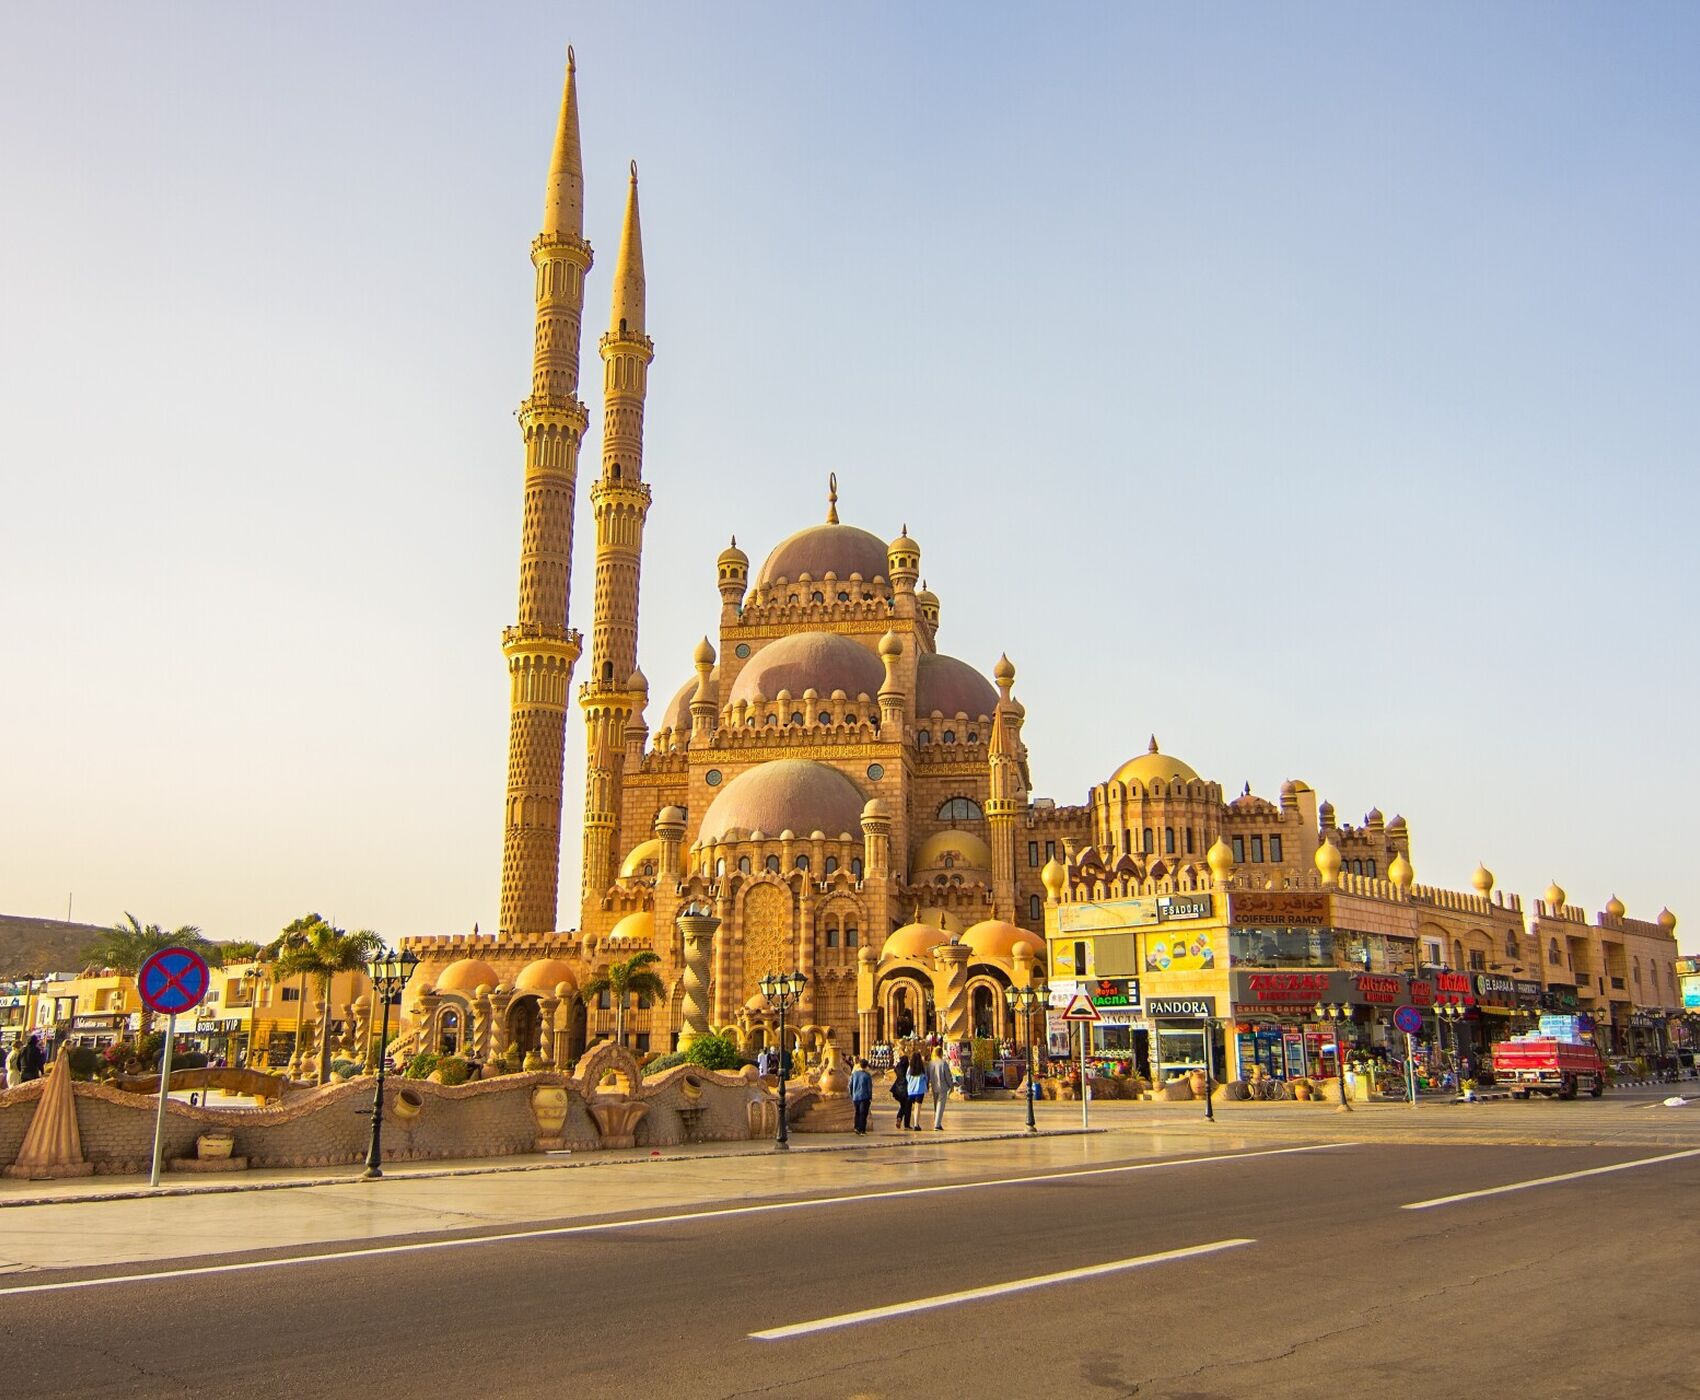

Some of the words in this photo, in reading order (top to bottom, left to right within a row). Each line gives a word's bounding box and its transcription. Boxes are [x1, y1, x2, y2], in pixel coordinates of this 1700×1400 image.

[1162, 903, 1205, 915] ESADORA
[1235, 915, 1285, 924] COIFFEUR
[1288, 915, 1324, 925] RAMZY
[1248, 973, 1329, 991] ZIGZAG
[1094, 987, 1118, 996] Royal
[1150, 1001, 1208, 1013] PANDORA
[225, 1020, 238, 1031] VIP
